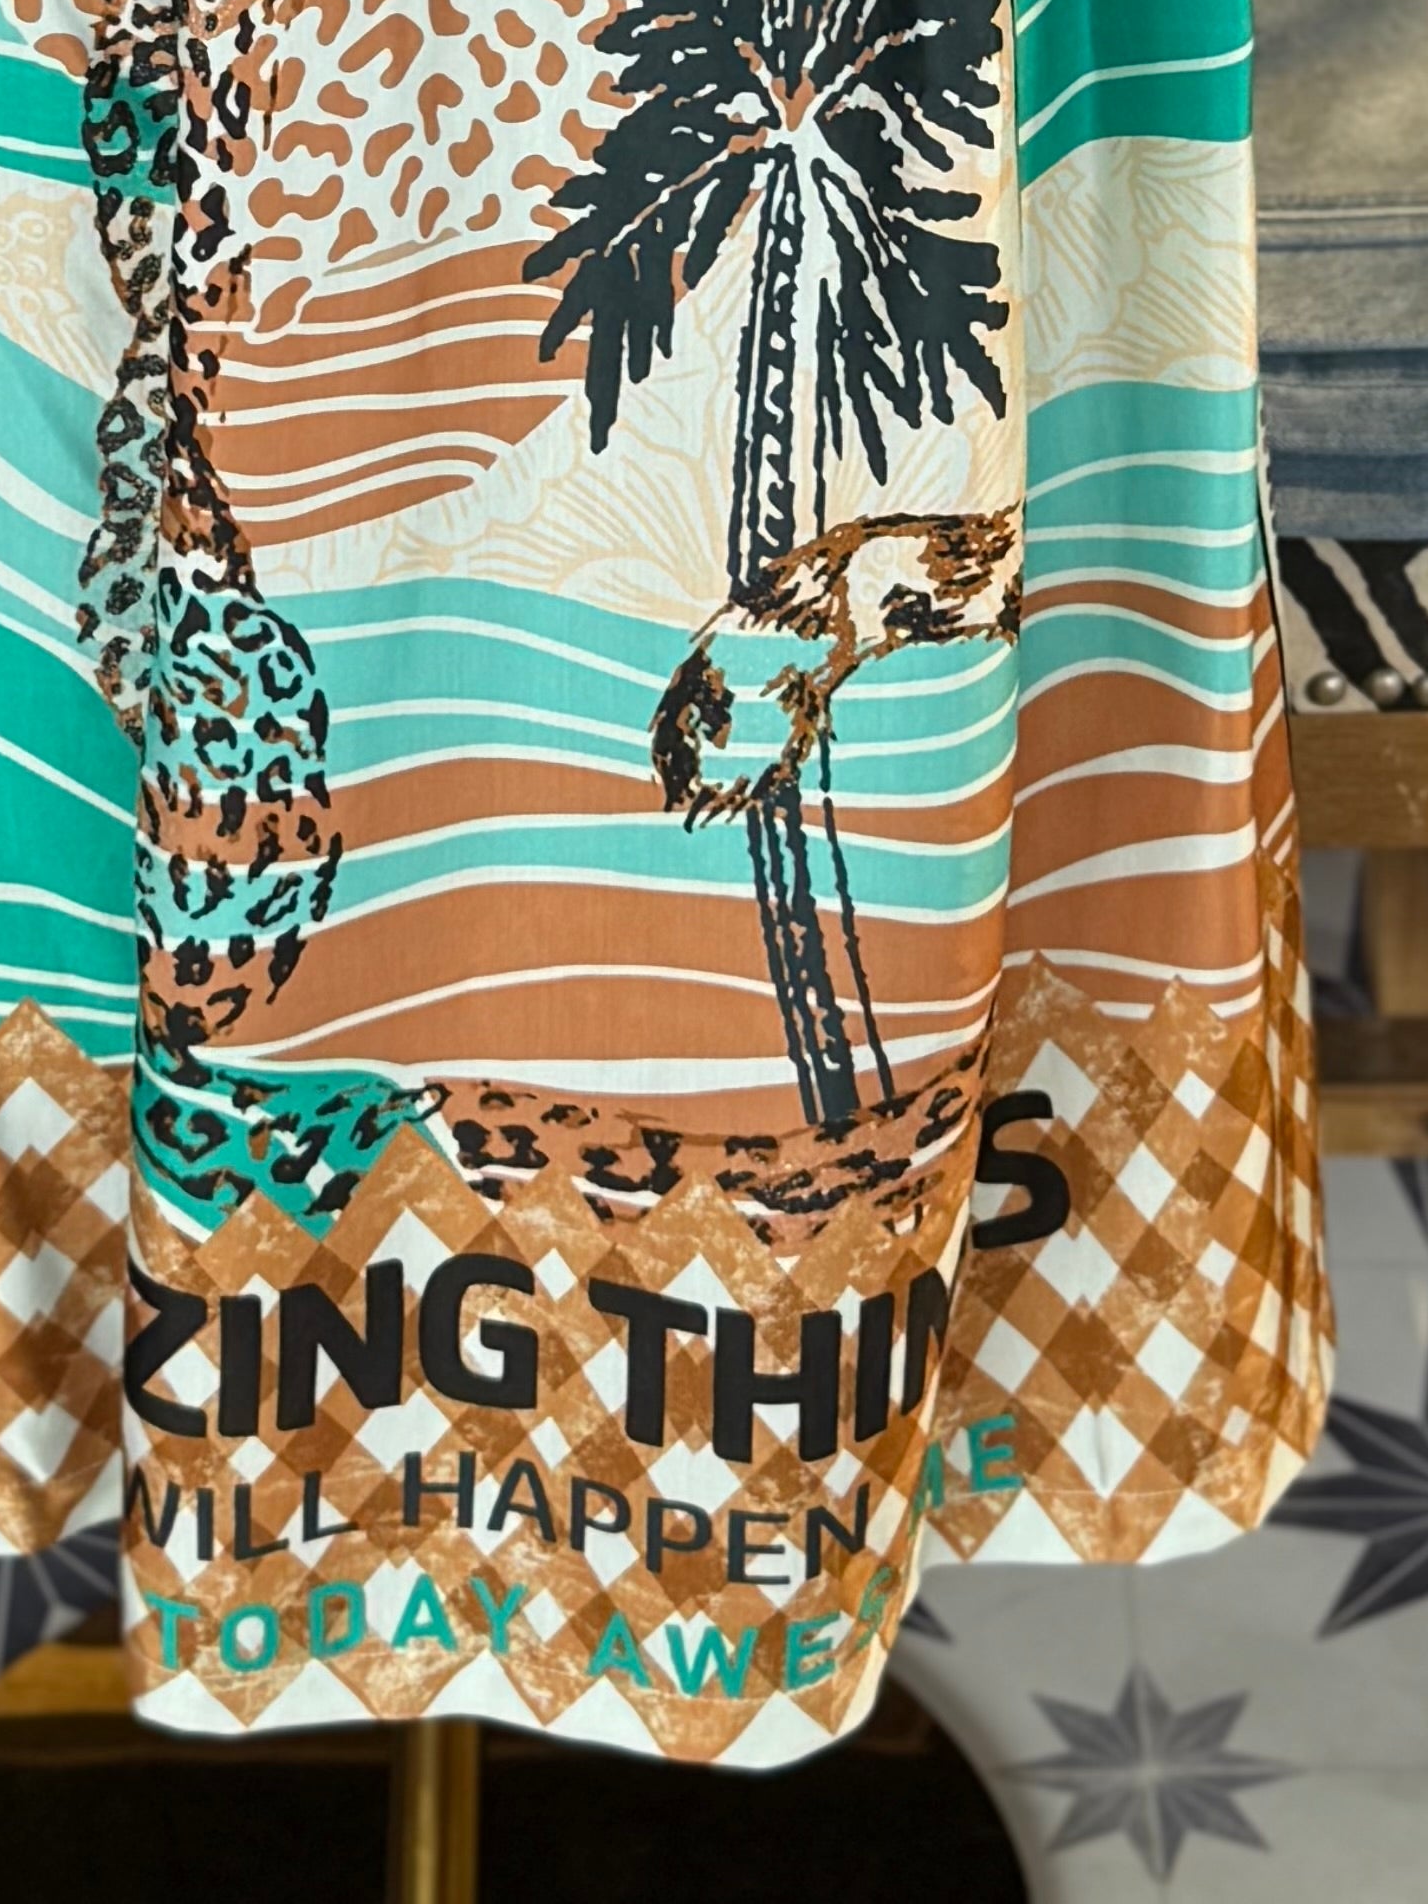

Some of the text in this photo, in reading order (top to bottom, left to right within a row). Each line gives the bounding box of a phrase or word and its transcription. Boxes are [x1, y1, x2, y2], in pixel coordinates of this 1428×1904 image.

[123, 1252, 539, 1439] ZING
[402, 1450, 871, 1586] HAPPEN
[143, 1573, 529, 1674] TODAY
